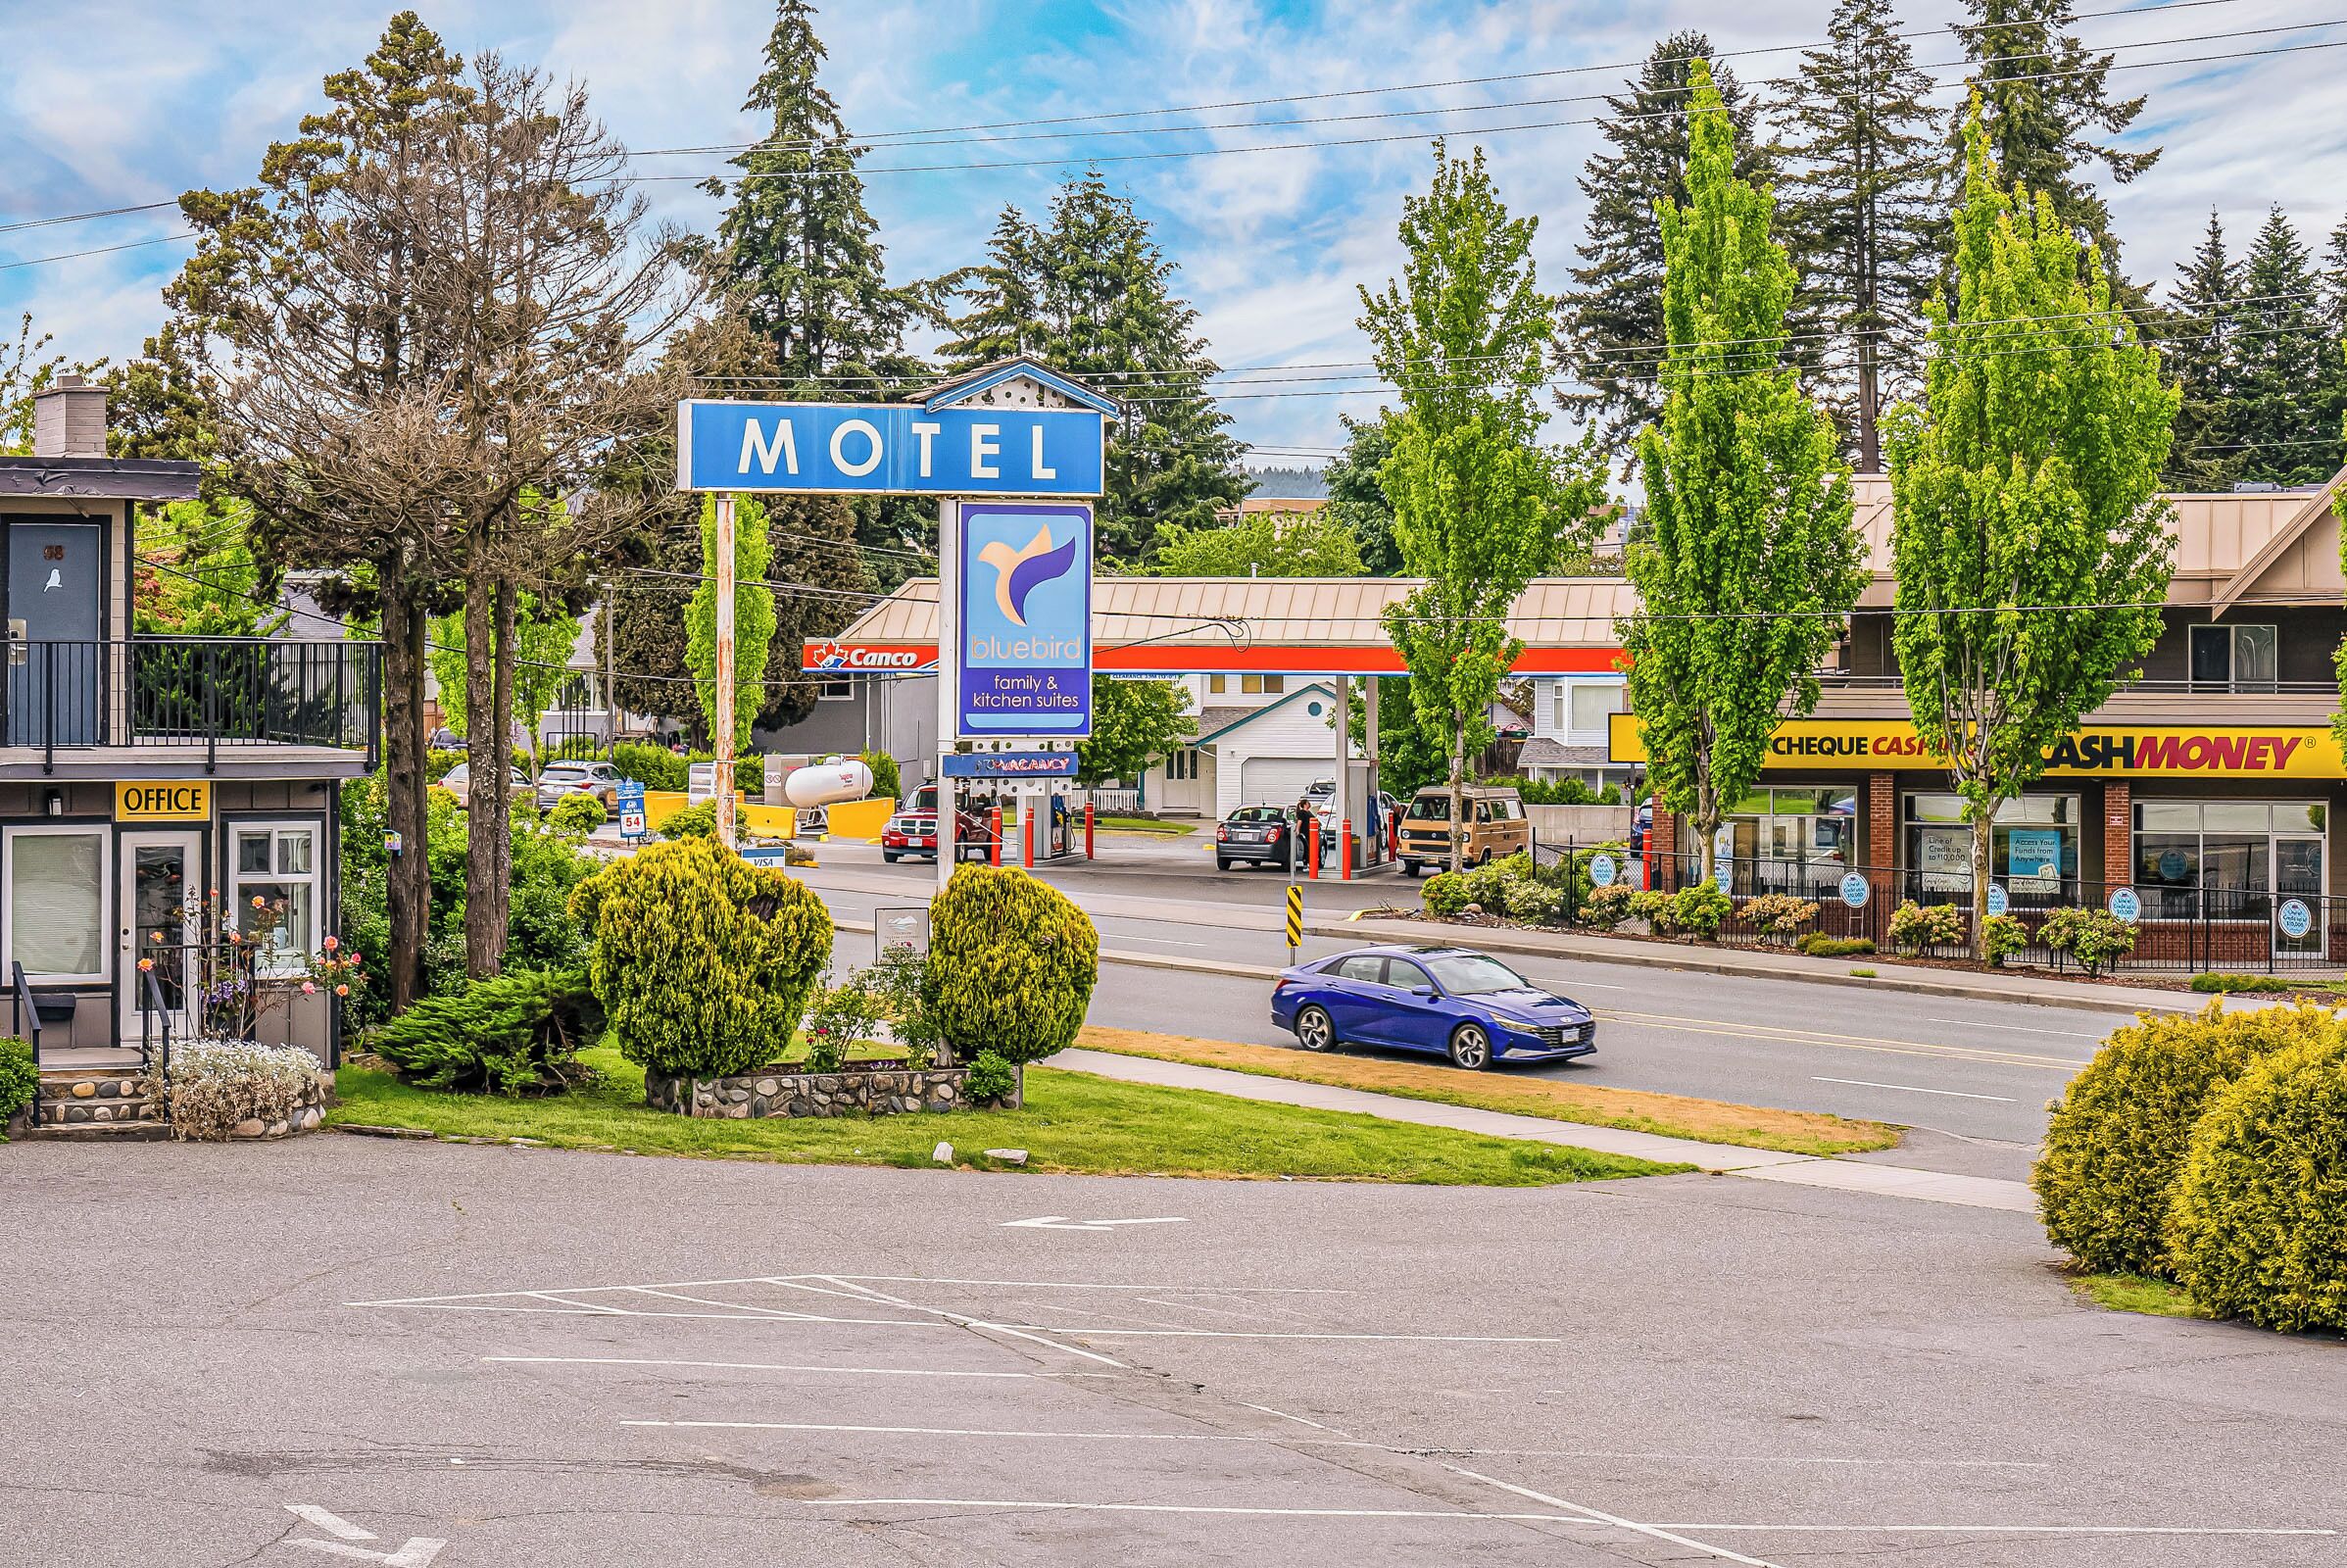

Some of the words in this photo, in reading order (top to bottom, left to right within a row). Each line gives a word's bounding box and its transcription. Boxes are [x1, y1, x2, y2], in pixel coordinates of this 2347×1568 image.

[738, 417, 1056, 479] MOTEL
[849, 648, 918, 666] Canco
[971, 634, 1082, 662] bluebird
[994, 674, 1042, 693] family
[1046, 676, 1058, 690] &
[972, 691, 1033, 709] kitchen
[1036, 693, 1079, 709] suites
[1772, 736, 1869, 758] CHEQUE
[996, 757, 1070, 771] VACANCY
[123, 788, 202, 811] OFFICE
[625, 816, 640, 827] 54
[754, 858, 773, 867] VISA
